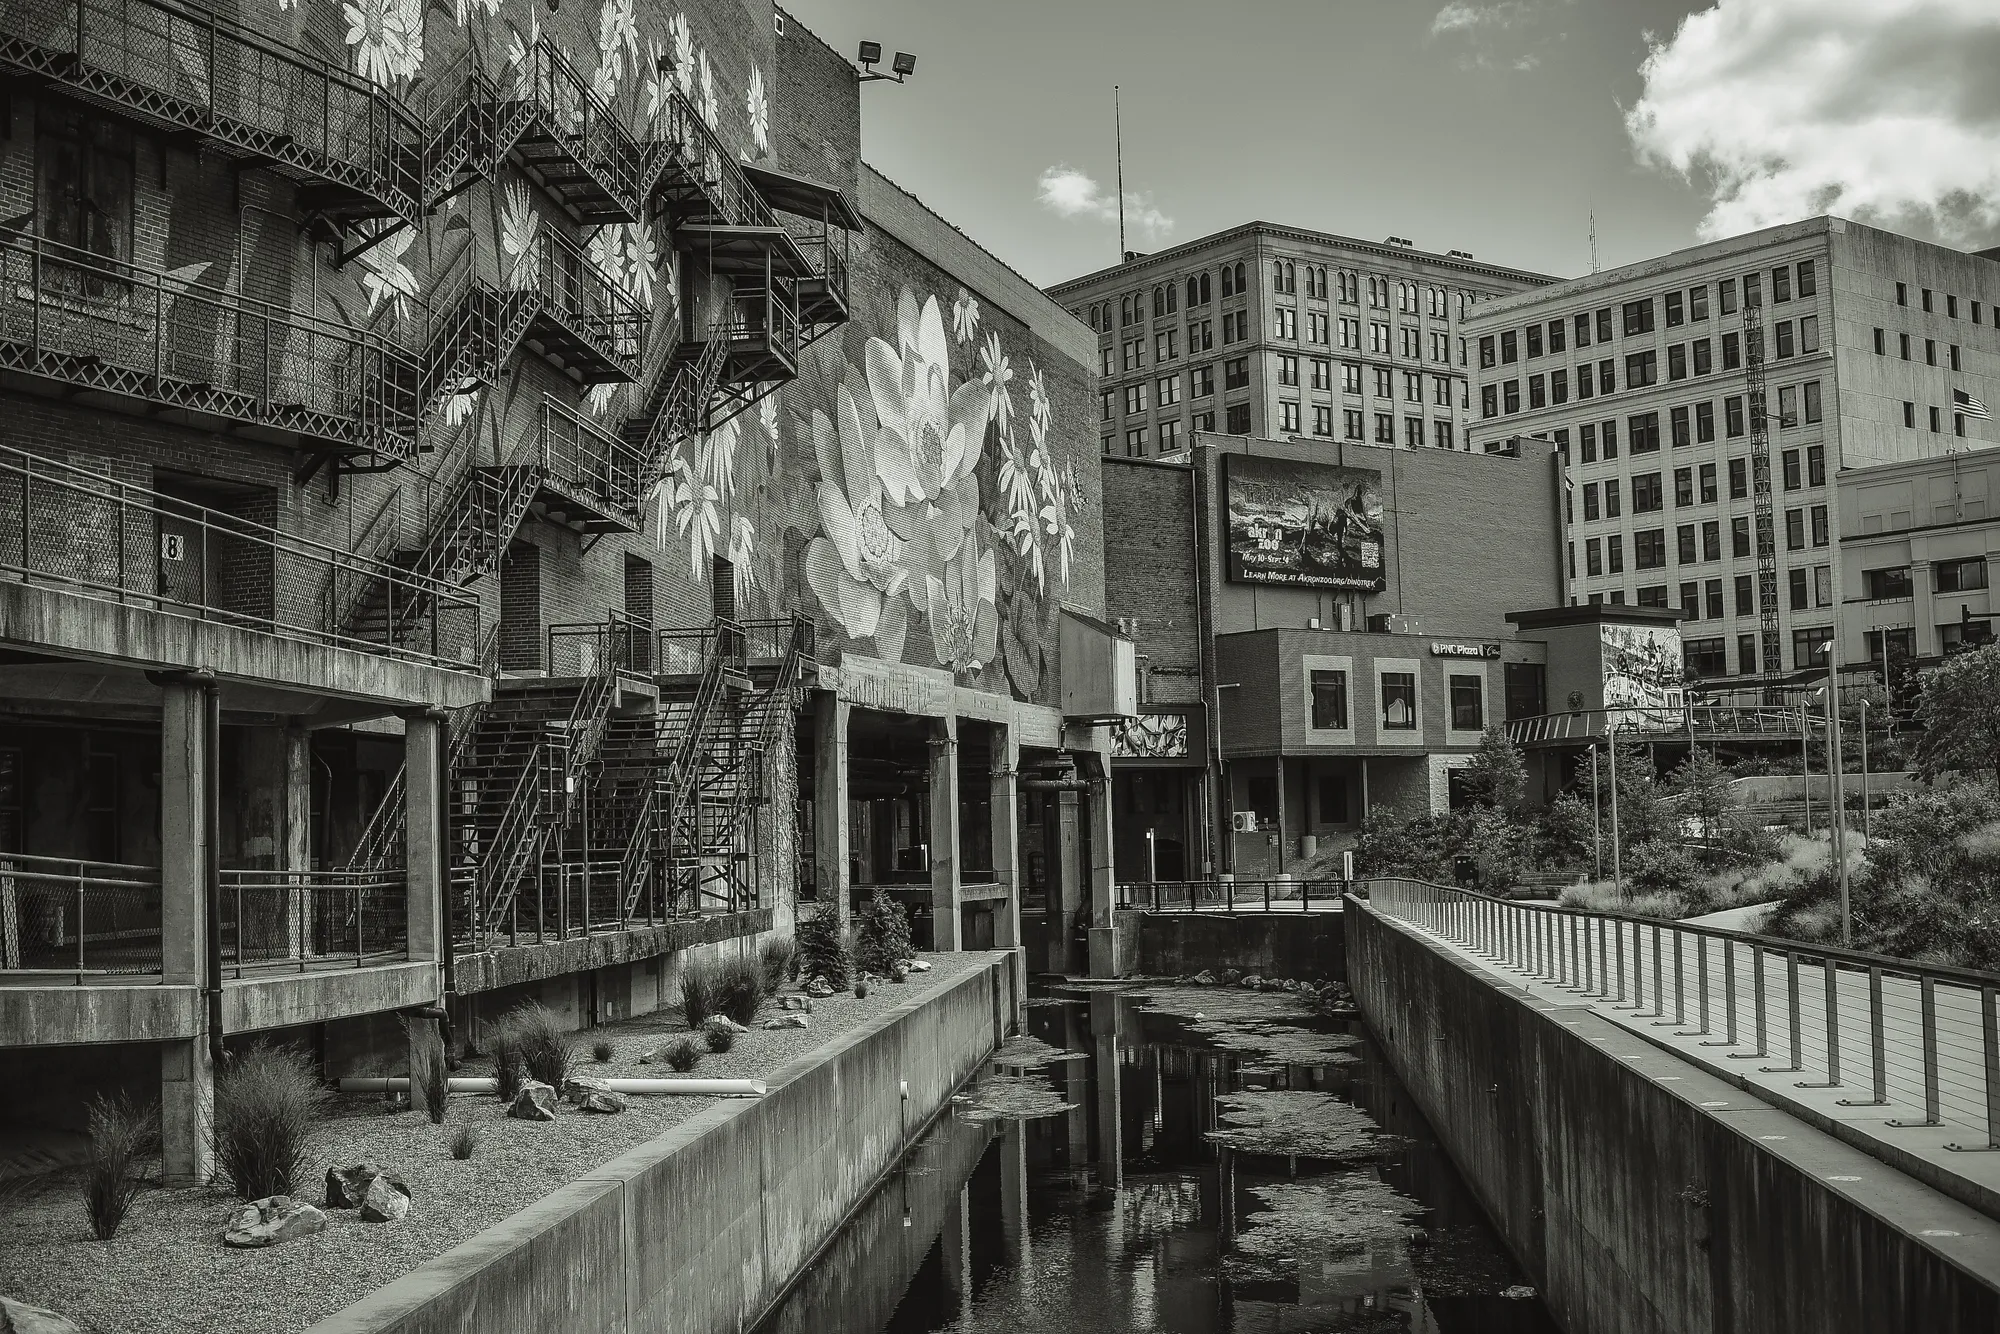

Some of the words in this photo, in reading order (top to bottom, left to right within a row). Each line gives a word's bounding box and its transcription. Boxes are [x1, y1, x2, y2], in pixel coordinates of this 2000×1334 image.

[168, 535, 178, 559] 8
[1257, 538, 1279, 551] zoo
[1440, 643, 1456, 654] PNC
[1457, 644, 1478, 655] Plaza
